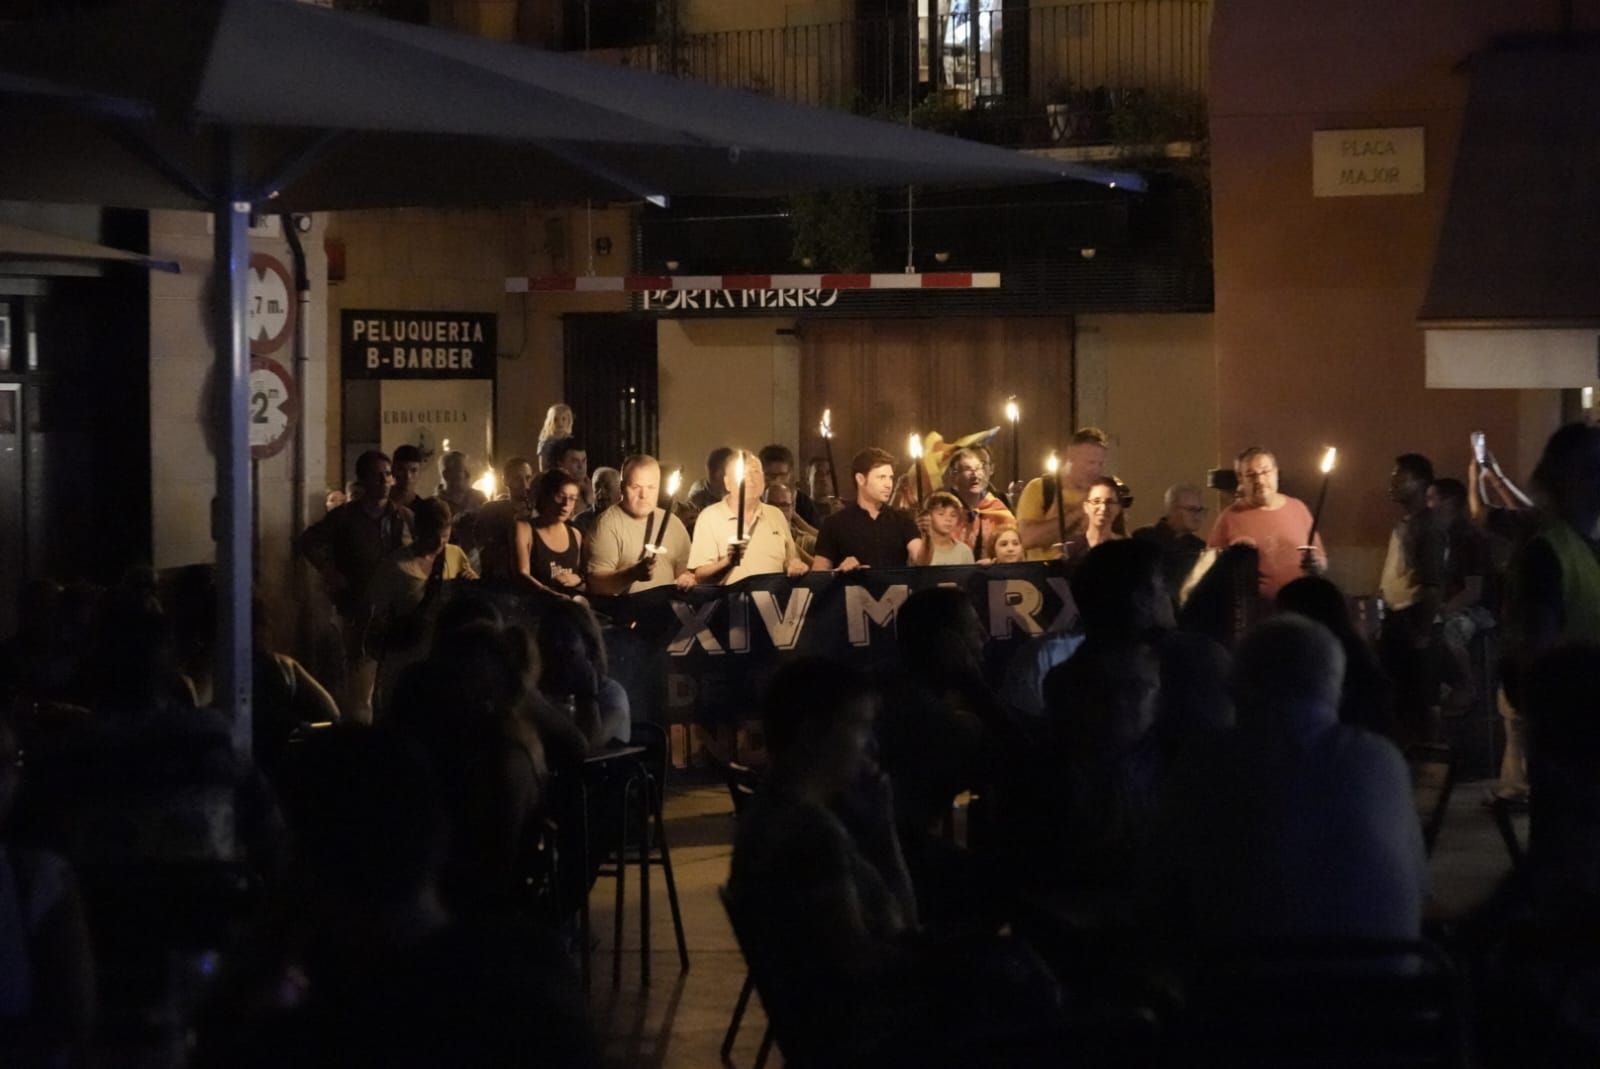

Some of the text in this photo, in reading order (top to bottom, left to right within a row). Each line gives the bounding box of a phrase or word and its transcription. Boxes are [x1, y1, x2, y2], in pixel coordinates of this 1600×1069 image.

[1339, 167, 1400, 184] MAJOR
[352, 320, 484, 343] PELUQUERIA
[366, 347, 474, 369] B-BARBER
[666, 576, 1082, 656] XIV MRX
